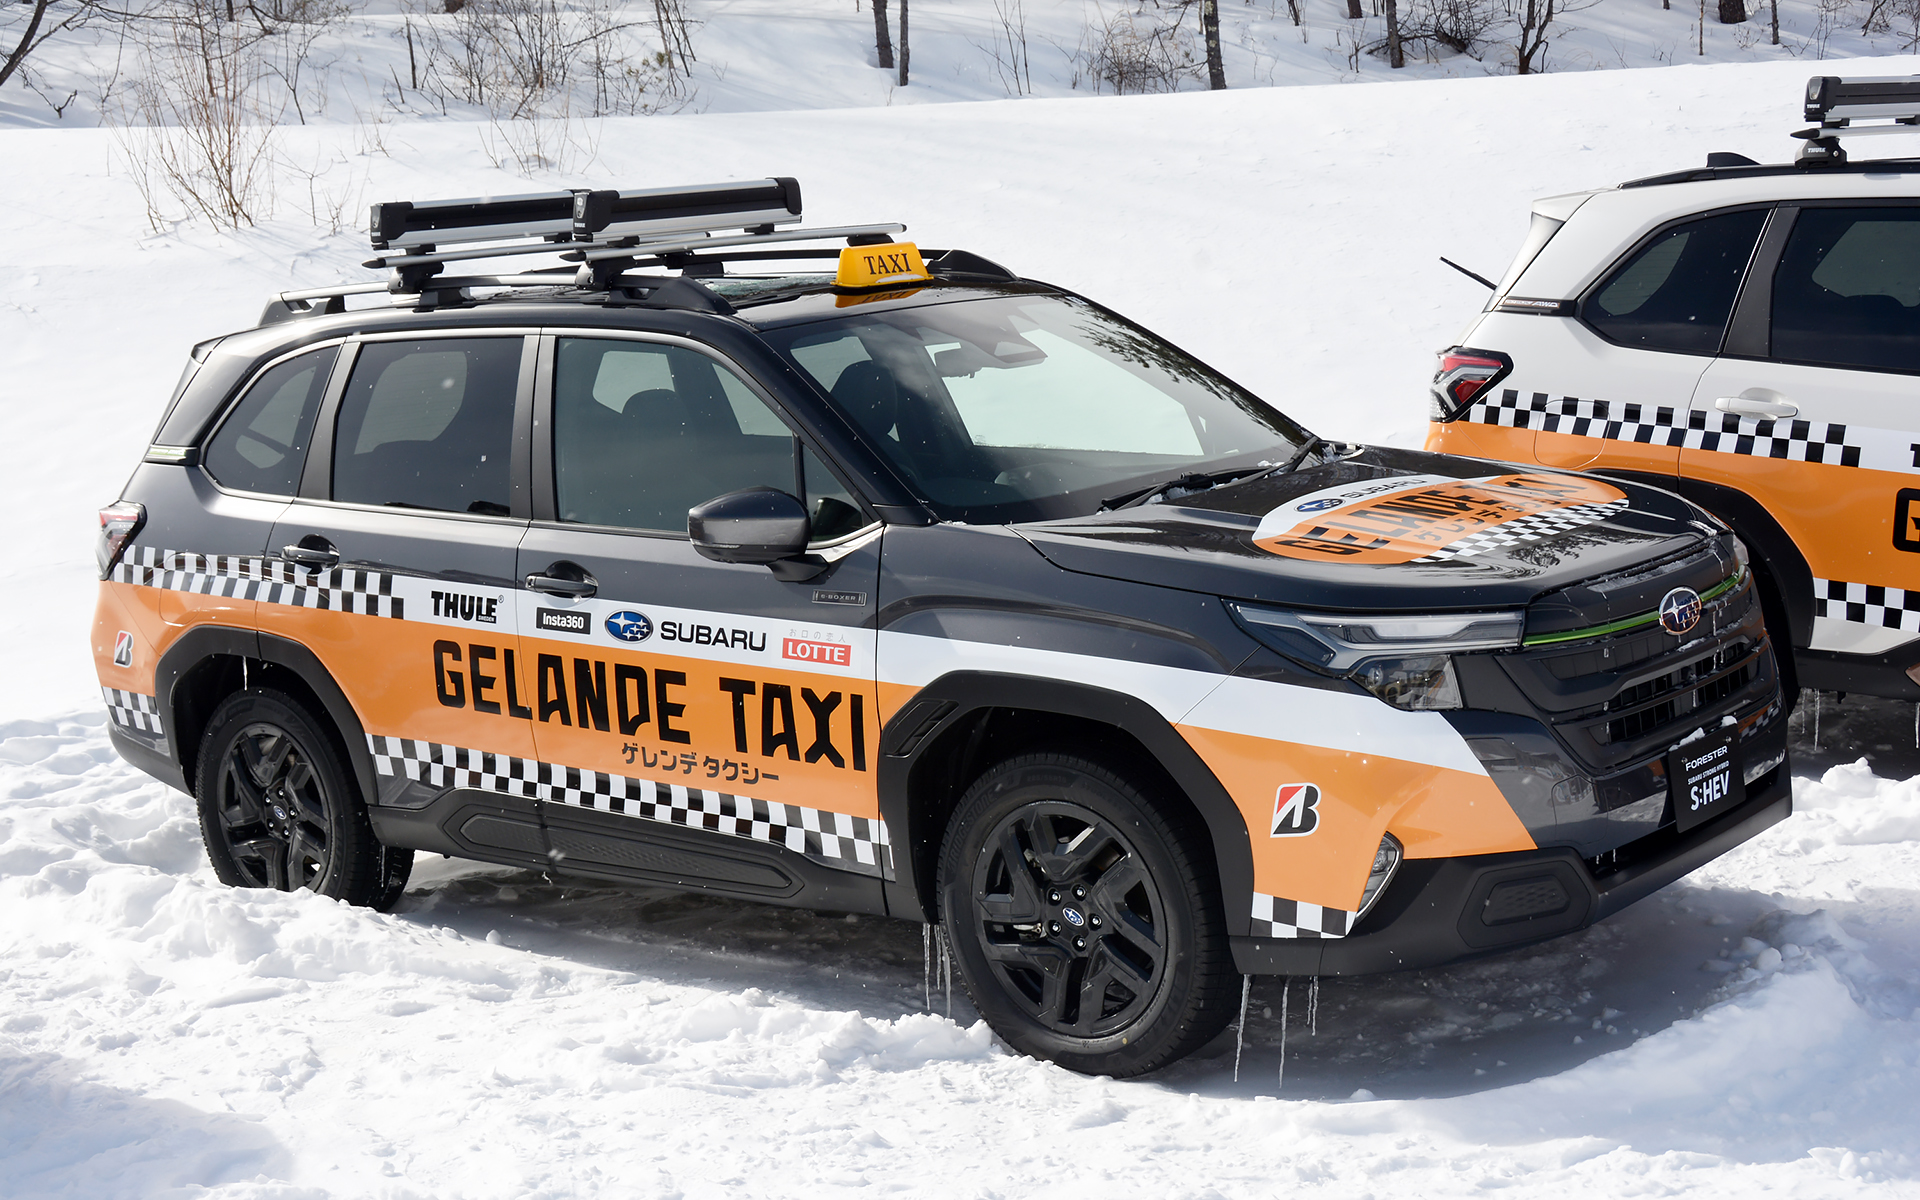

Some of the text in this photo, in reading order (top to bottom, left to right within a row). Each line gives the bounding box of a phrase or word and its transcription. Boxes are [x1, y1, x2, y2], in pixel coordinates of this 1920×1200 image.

[864, 253, 912, 275] TAXI
[1340, 479, 1428, 498] SUBARU
[1273, 478, 1588, 556] GELANDE TAXI
[431, 590, 498, 623] THULE
[542, 612, 584, 630] Insta360
[660, 620, 767, 652] SUBARU
[788, 641, 845, 662] LOTTE
[433, 639, 866, 772] GELANDE TAXI
[1685, 745, 1728, 772] FORESTER
[1690, 770, 1730, 811] S:HEV
